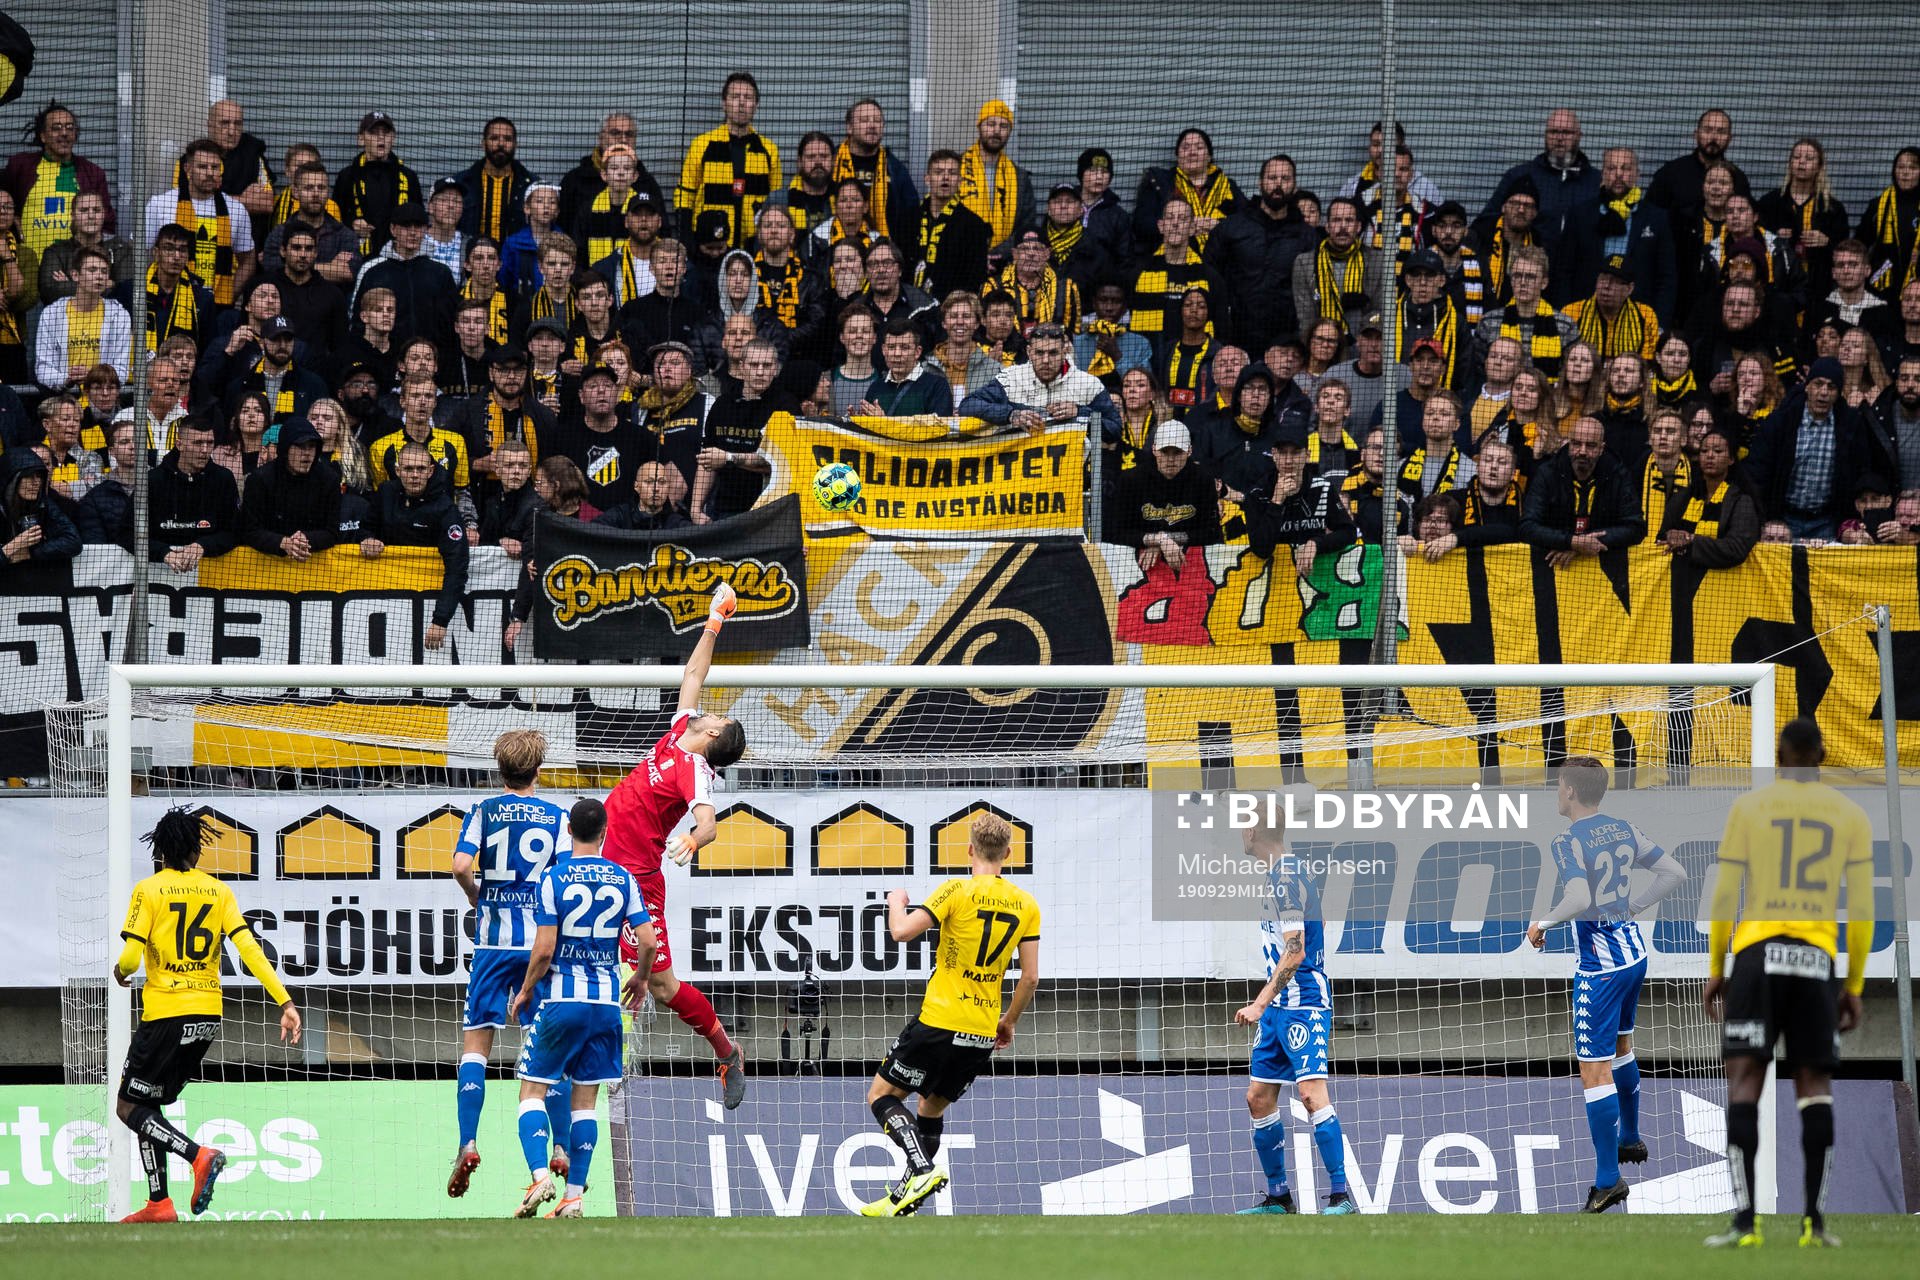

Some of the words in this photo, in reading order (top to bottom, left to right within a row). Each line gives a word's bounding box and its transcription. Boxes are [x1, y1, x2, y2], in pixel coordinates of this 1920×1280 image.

[32, 218, 69, 230] AVIV
[875, 500, 906, 519] DE
[915, 491, 1066, 519] AVSTÄNGDA
[544, 544, 797, 628] Bandieras
[677, 596, 696, 617] 12
[488, 812, 556, 825] WELLNESS
[498, 803, 546, 816] NORDIC
[484, 826, 554, 882] 19
[568, 864, 614, 876] NORDIC
[1771, 819, 1834, 891] 12
[160, 885, 219, 897] Glimstedt
[558, 873, 626, 885] WELLNESS
[1594, 844, 1635, 907] 23
[127, 891, 144, 929] stadium
[500, 889, 538, 903] KONTA
[562, 884, 624, 938] 22
[931, 881, 962, 910] stadium
[169, 902, 214, 961] 16
[219, 895, 476, 976] SJÖHU
[691, 891, 1021, 972] EKSJÖH
[975, 909, 1020, 967] 17
[165, 962, 207, 974] MAXXIS
[1300, 1054, 1310, 1068] 7
[705, 1098, 977, 1217] iver
[1289, 1097, 1561, 1215] iver
